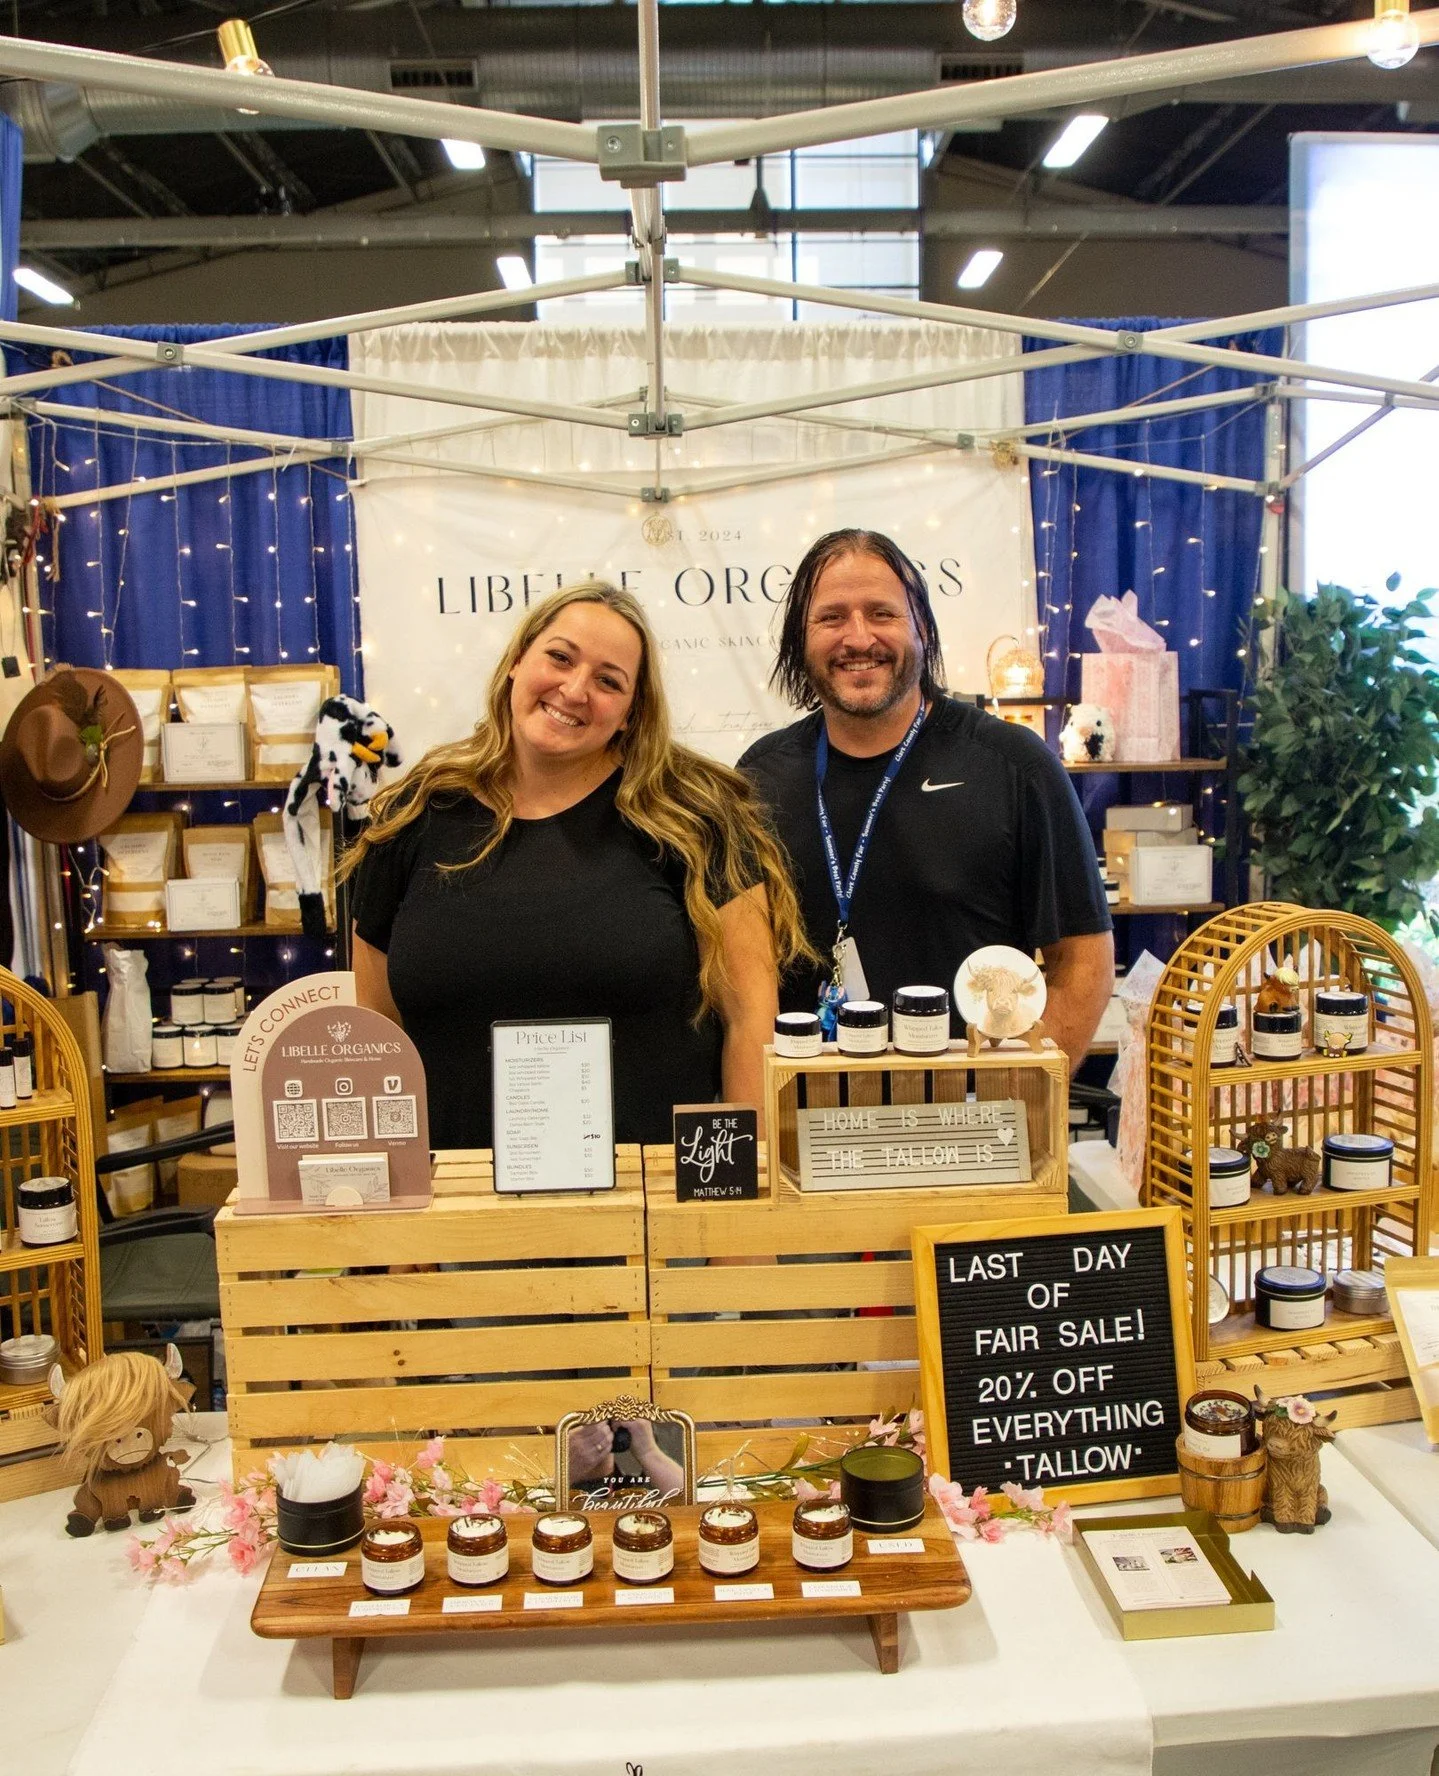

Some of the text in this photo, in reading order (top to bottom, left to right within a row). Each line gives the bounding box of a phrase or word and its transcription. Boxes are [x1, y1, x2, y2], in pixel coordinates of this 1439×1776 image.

[698, 530, 741, 541] 2024
[243, 985, 340, 1073] LET'S CONNECT
[515, 1029, 588, 1045] Price List
[281, 1041, 402, 1058] LIBELLE ORGANICS
[712, 1118, 738, 1130] BE THE
[823, 1105, 1003, 1131] HOME IS WHERE
[680, 1125, 754, 1184] Light
[826, 1149, 864, 1171] THE
[975, 1144, 995, 1164] IS
[693, 1186, 728, 1197] MATTHEW
[949, 1243, 1132, 1284] LAST DAY
[1027, 1282, 1071, 1310] OF
[975, 1308, 1146, 1356] FAIR SALE!
[978, 1364, 1114, 1404] 20% OFF
[972, 1400, 1165, 1446] EVERYTHING
[603, 1476, 624, 1484] YOU
